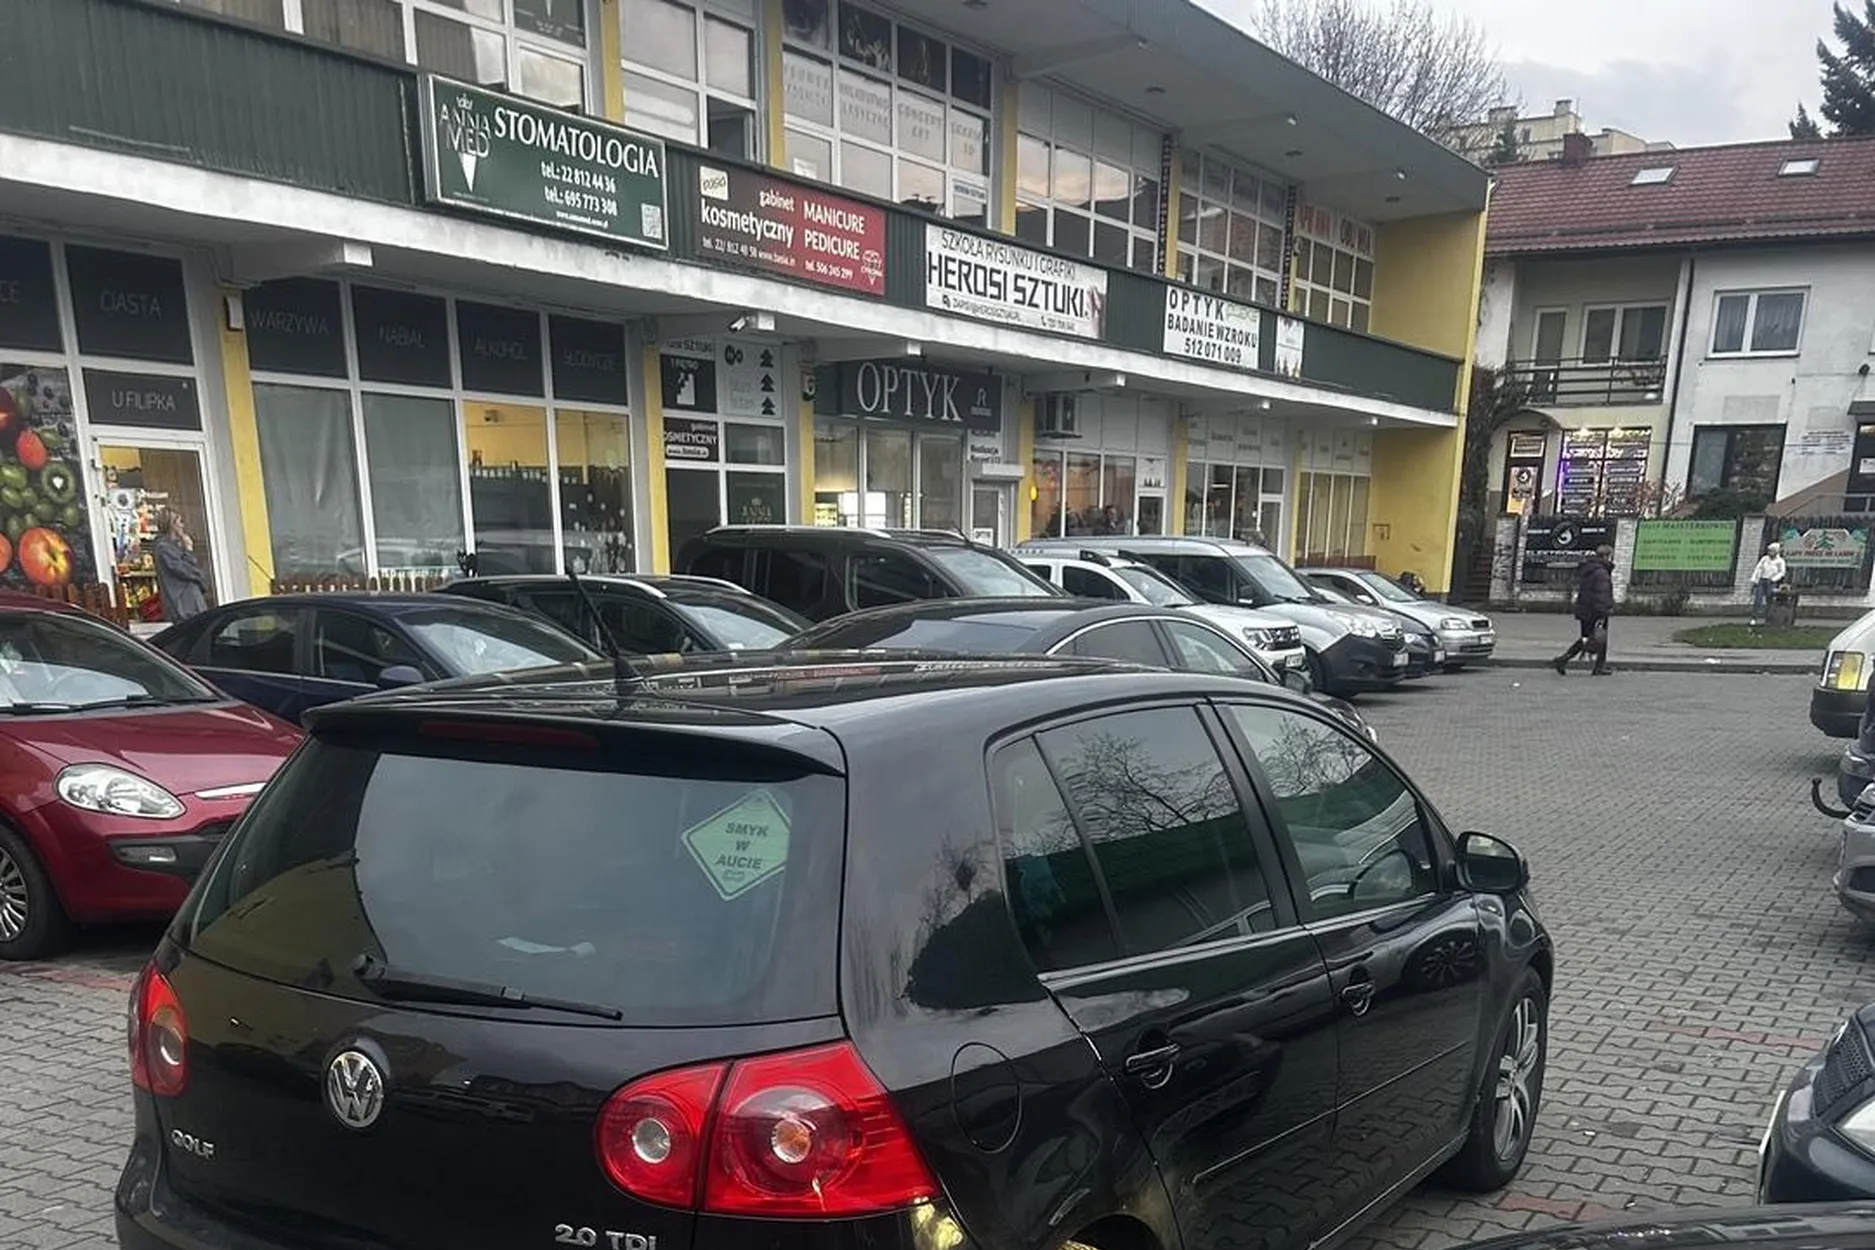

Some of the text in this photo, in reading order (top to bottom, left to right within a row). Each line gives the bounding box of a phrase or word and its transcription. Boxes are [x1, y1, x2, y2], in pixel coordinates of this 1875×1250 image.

[439, 104, 491, 139] ANNA
[446, 126, 489, 157] MED
[494, 107, 660, 178] STOMATOLOGIA
[561, 165, 573, 183] 22
[574, 168, 591, 188] 812
[582, 193, 600, 212] 773
[760, 190, 795, 212] gabinet
[701, 198, 794, 248] kosmetyczny
[803, 201, 865, 234] MANICURE
[804, 229, 860, 260] PEDICURE
[928, 251, 1008, 301] HEROSI
[1013, 273, 1084, 318] SZTUKI
[100, 289, 161, 316] CIASTA
[1169, 289, 1224, 321] OPTYK
[249, 309, 328, 334] WARZYWA
[1167, 313, 1258, 348] BADANIE WZROKU
[1184, 337, 1202, 355] 512
[1205, 341, 1222, 359] 071
[112, 390, 123, 408] U
[857, 362, 963, 421] OPTYK
[725, 822, 769, 837] SMYK
[736, 840, 751, 851] W
[714, 854, 763, 869] AUCIE
[171, 1129, 214, 1159] GOLF
